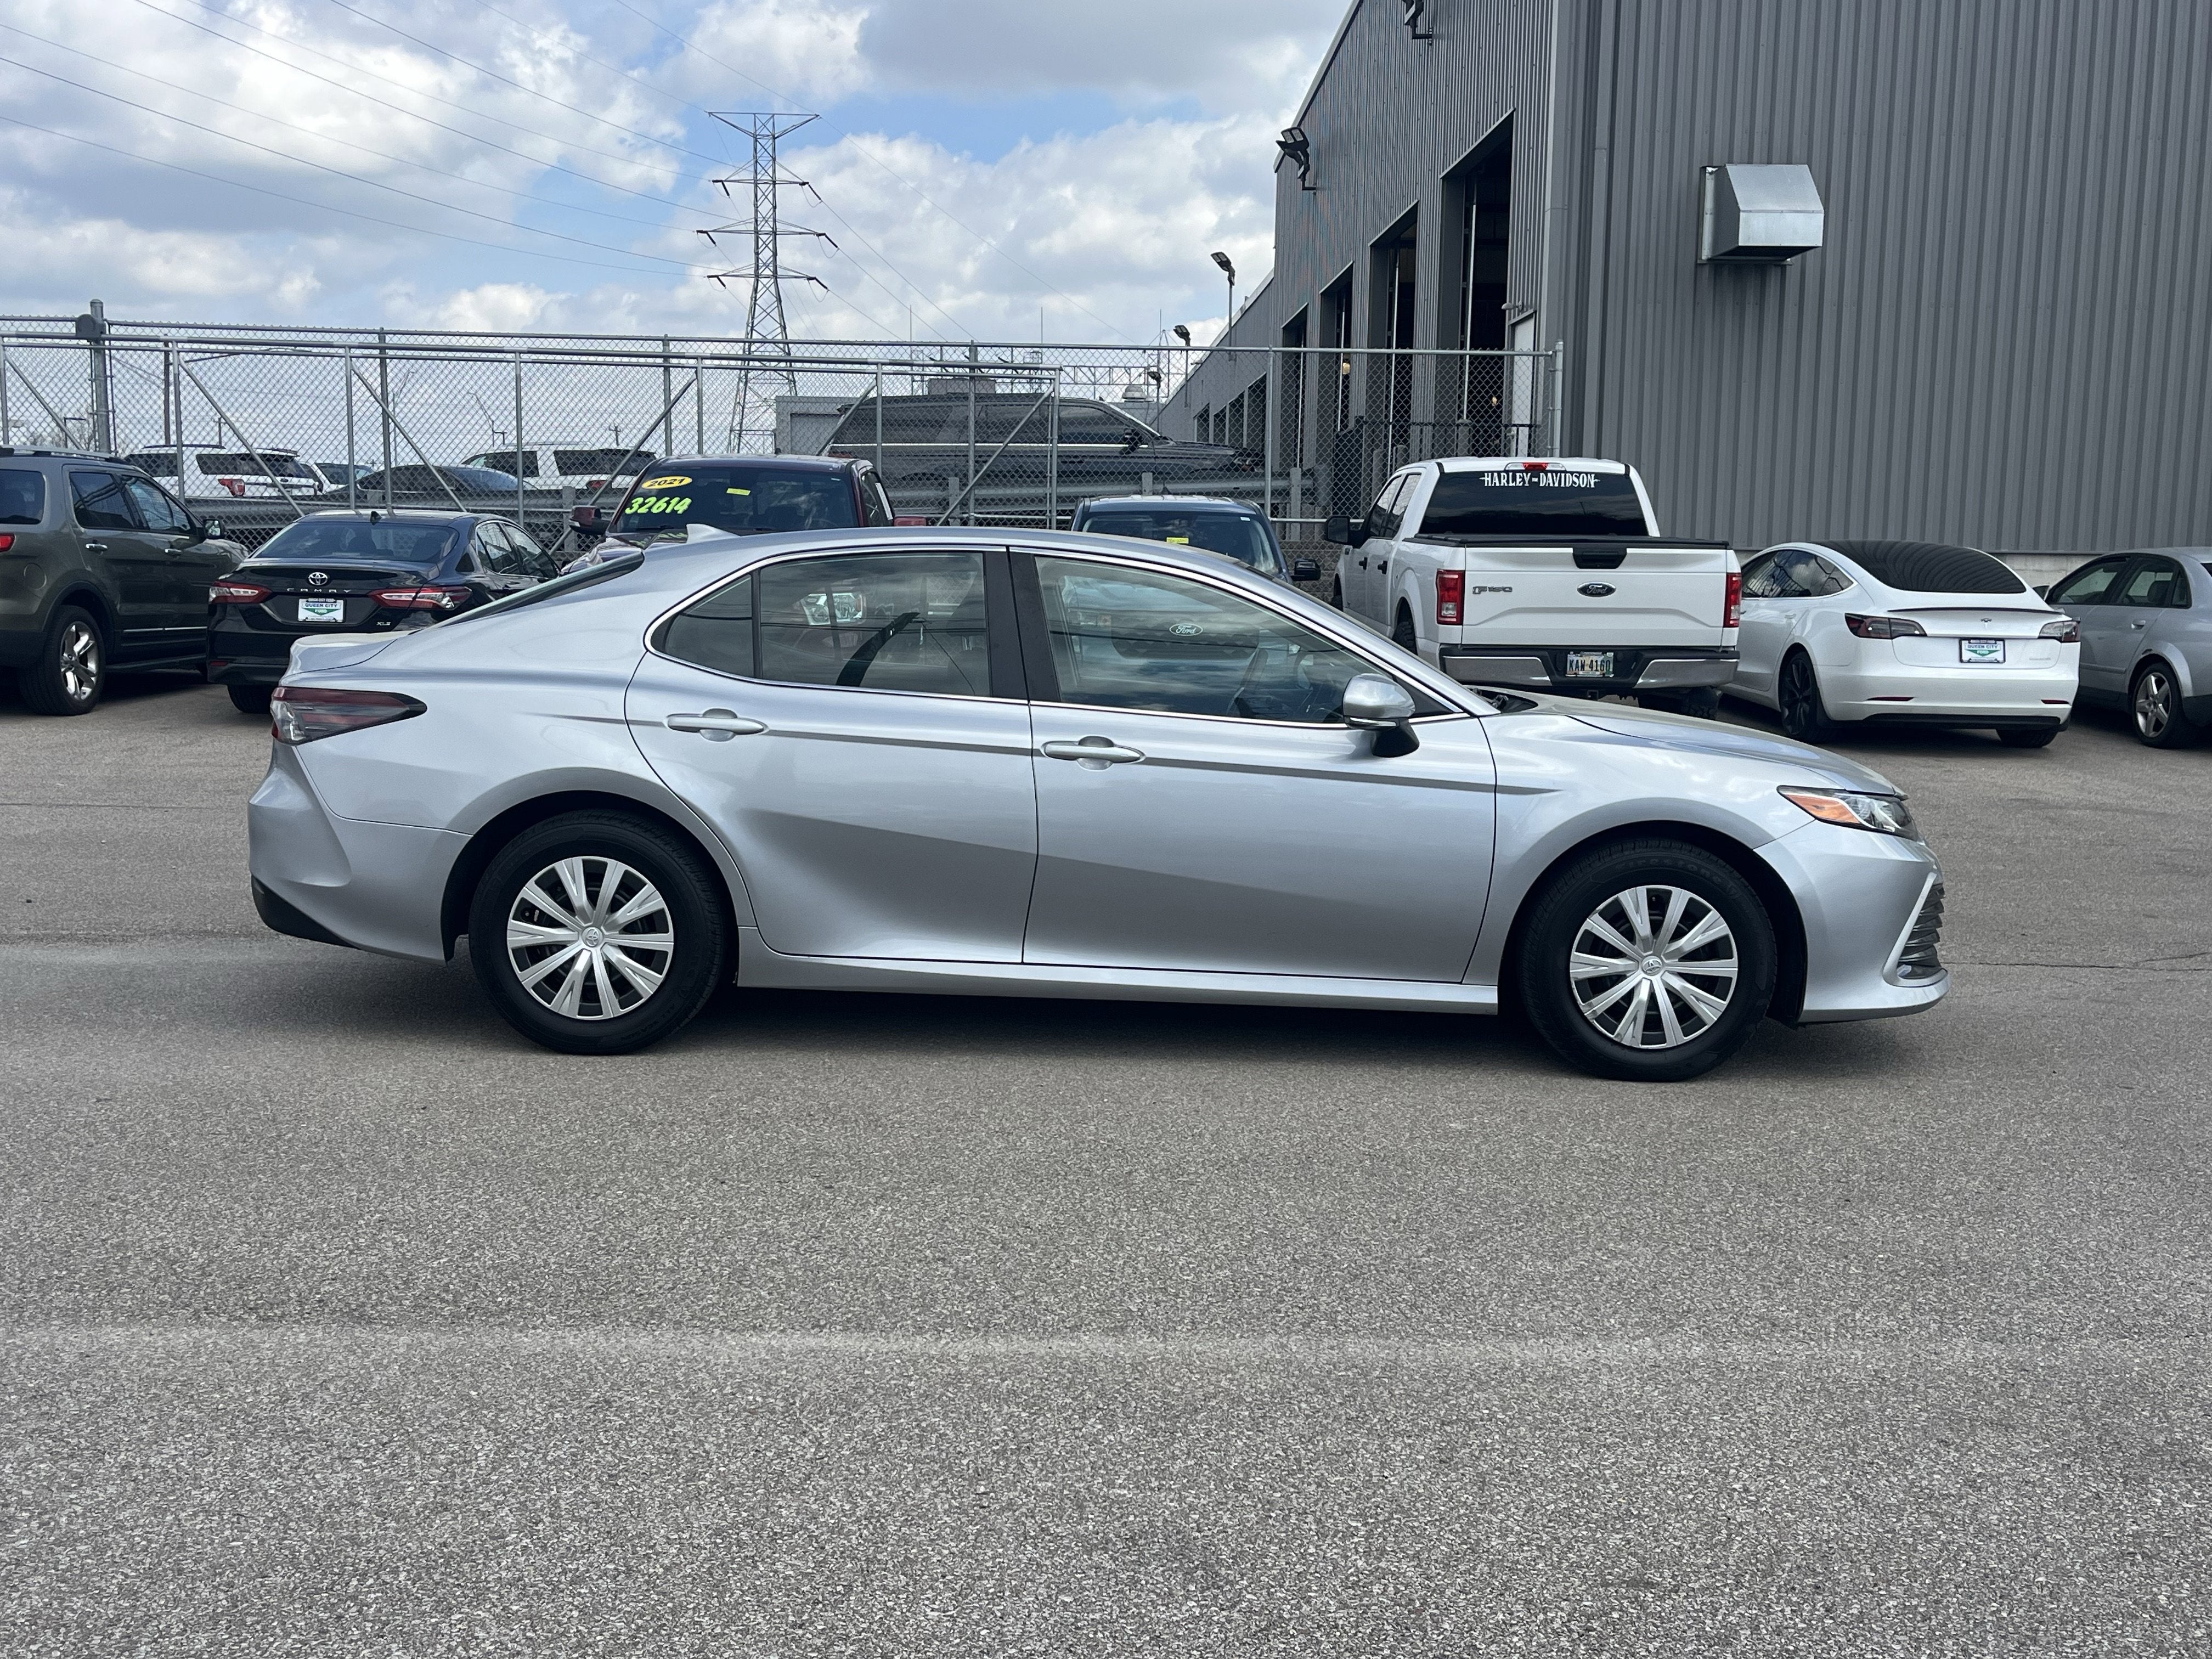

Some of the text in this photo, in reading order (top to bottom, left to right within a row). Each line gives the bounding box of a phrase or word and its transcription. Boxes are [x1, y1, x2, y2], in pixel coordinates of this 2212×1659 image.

[647, 478, 686, 487] 2021
[1483, 472, 1595, 488] HARLEY-DAVIDSON
[625, 496, 692, 514] 32614
[1589, 659, 1610, 672] 4160
